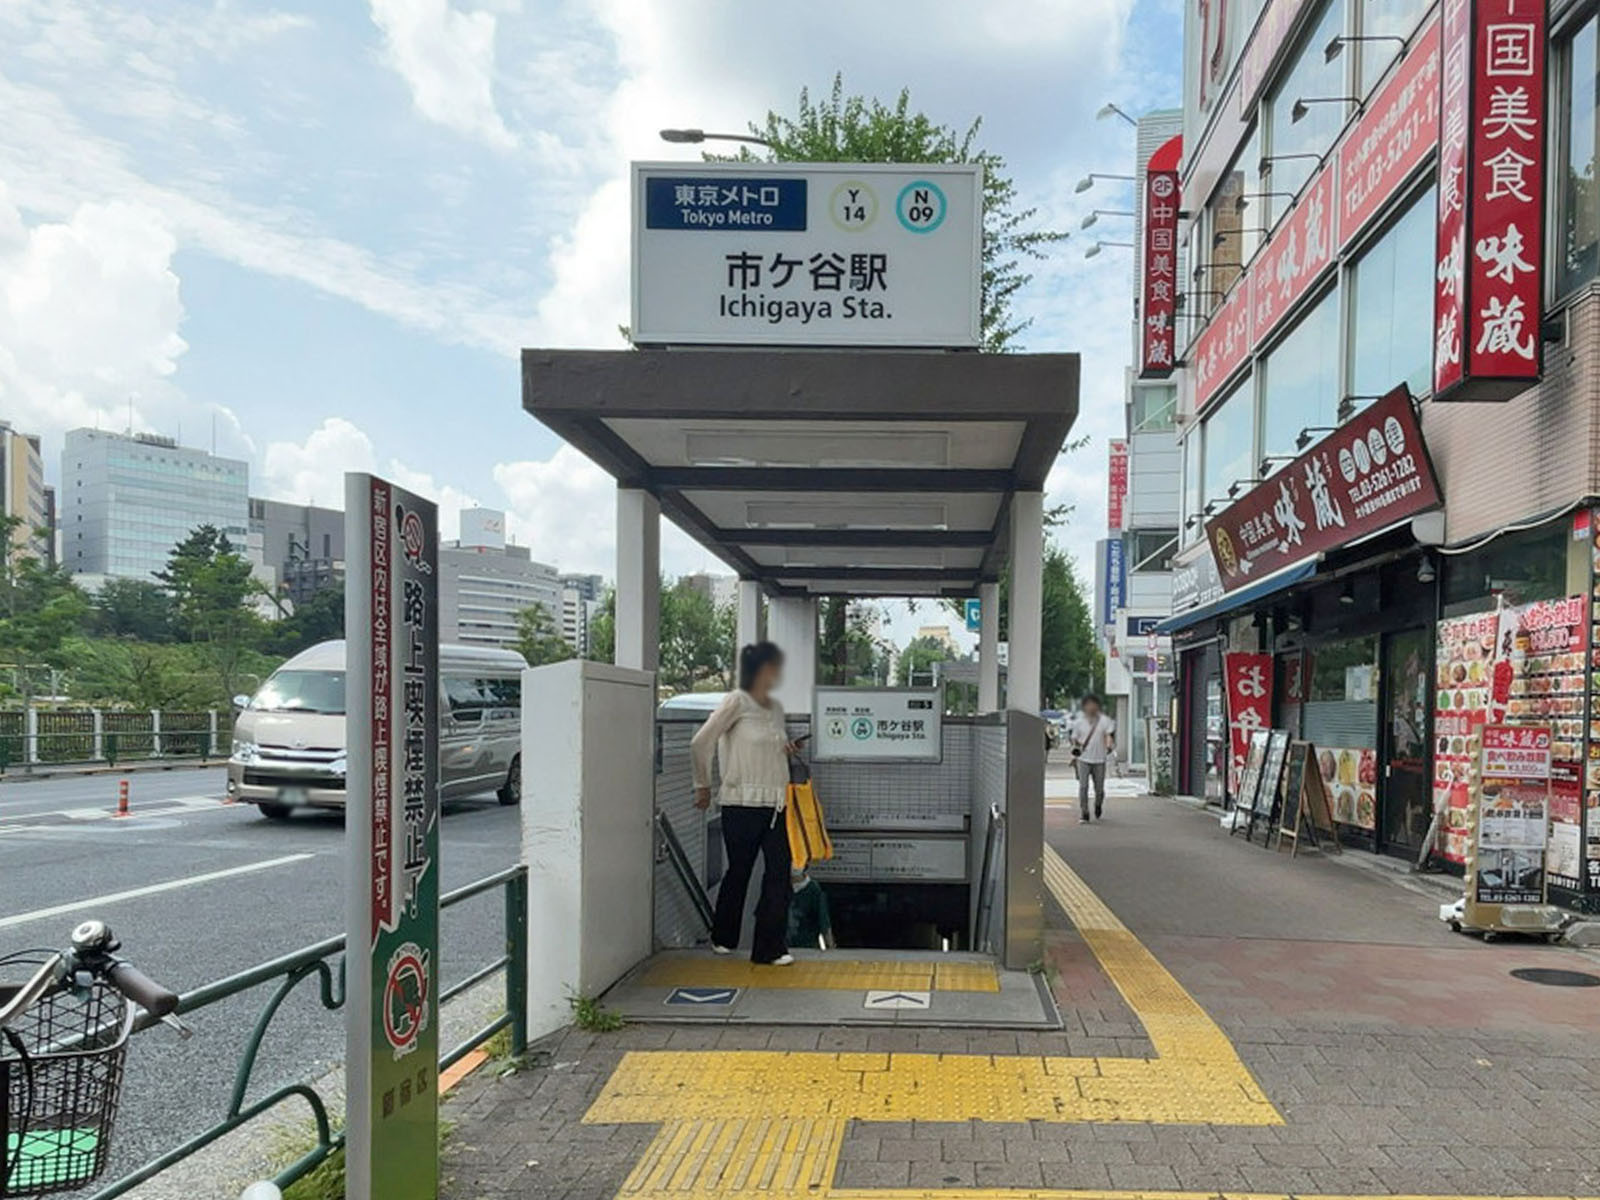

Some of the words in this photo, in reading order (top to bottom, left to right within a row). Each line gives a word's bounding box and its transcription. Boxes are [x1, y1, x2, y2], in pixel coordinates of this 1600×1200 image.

[1154, 180, 1171, 193] 2F
[674, 185, 779, 206] 東京メトロ
[847, 189, 860, 203] Y
[914, 190, 929, 203] N
[681, 209, 725, 227] Tokyo
[728, 209, 773, 225] Metro
[843, 206, 867, 222] 14
[908, 206, 934, 223] 09
[725, 251, 888, 291] 市ケ谷駅
[1476, 223, 1535, 360] 味蔵
[720, 295, 832, 324] Ichigaya
[842, 295, 893, 320] Sta.
